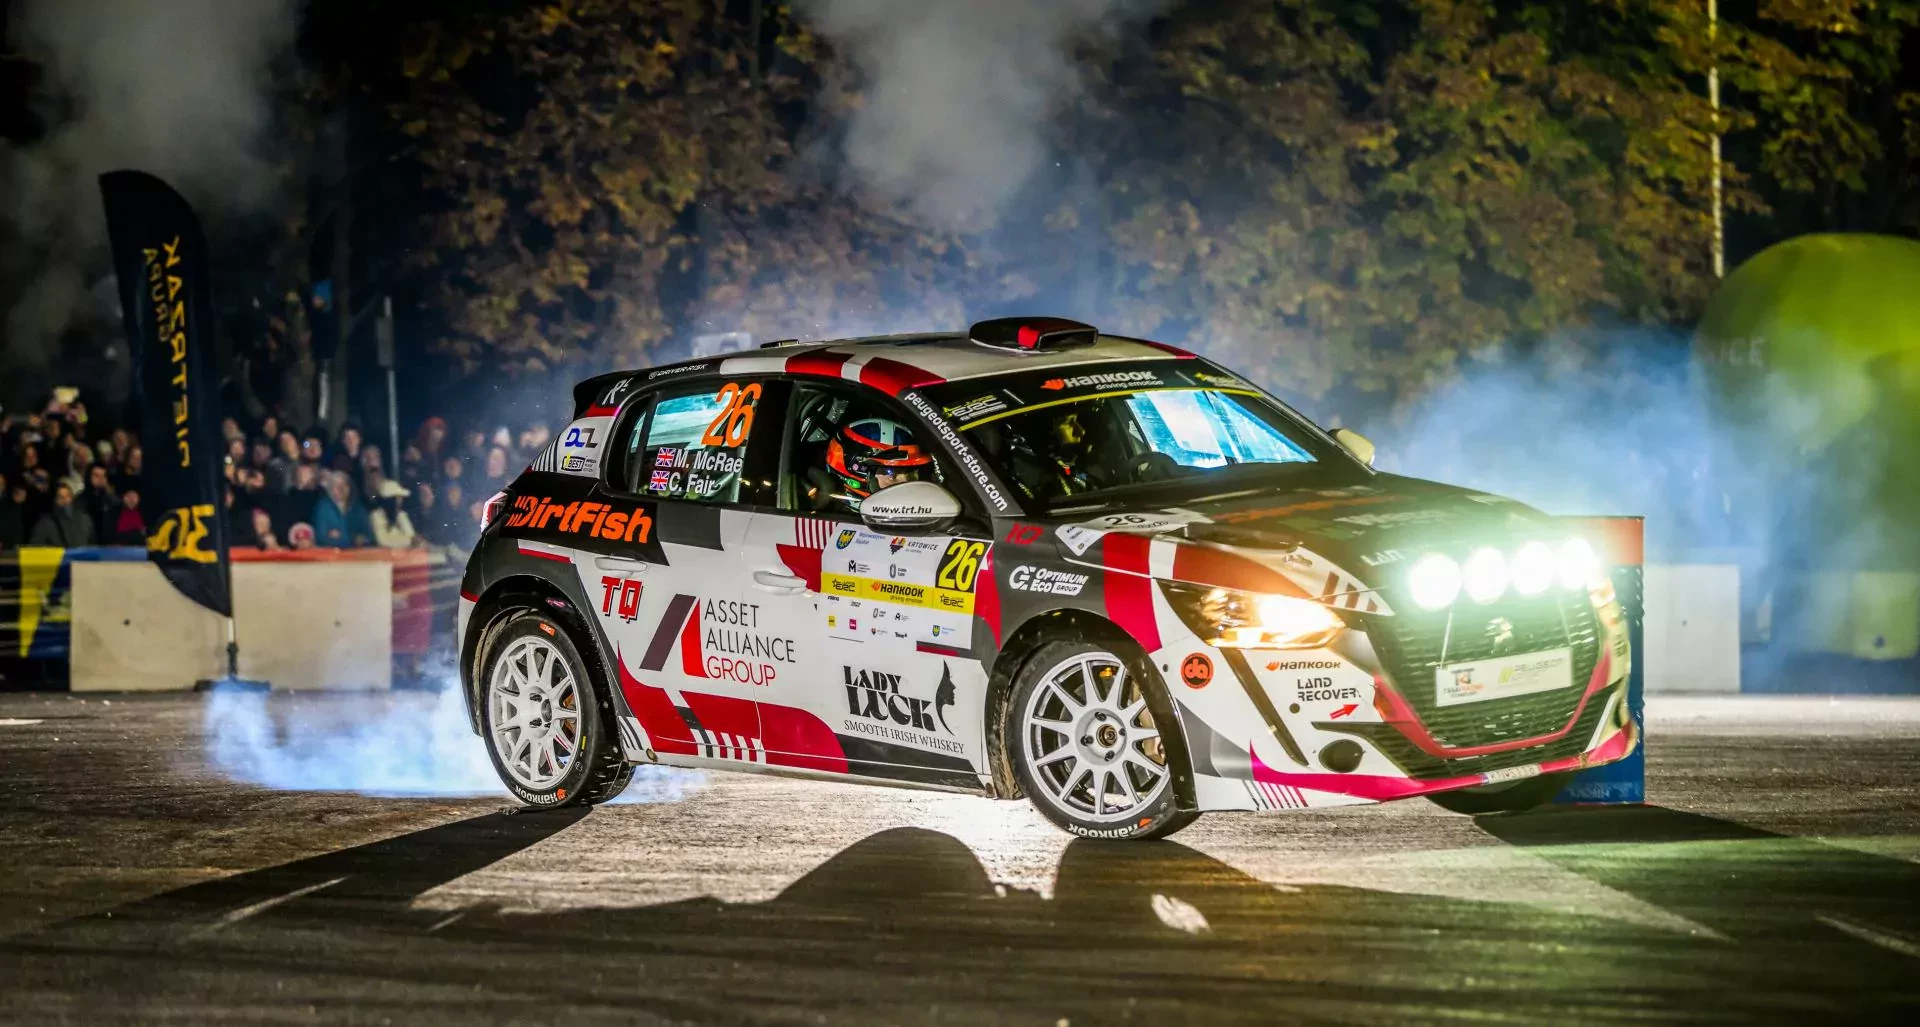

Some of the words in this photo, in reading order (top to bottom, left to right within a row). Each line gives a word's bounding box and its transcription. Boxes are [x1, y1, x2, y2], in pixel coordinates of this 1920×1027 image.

[1095, 383, 1127, 391] driving
[701, 382, 762, 448] 26
[673, 449, 689, 468] M.
[693, 450, 743, 473] McRae
[904, 391, 1009, 512] peugeotsport-store.com
[668, 472, 682, 492] C.
[686, 473, 716, 495] Fair
[505, 495, 653, 544] DirtFish
[872, 505, 932, 515] www.trt.hu
[1105, 514, 1146, 526] 26
[907, 541, 939, 551] KATOWICE
[938, 539, 985, 592] 26
[1036, 567, 1090, 585] OPTIMUM
[601, 575, 644, 624] TQ
[1029, 579, 1053, 593] ECO
[1056, 584, 1078, 593] GROUP
[704, 598, 760, 628] ASSET
[705, 628, 796, 664] ALLIANCE
[707, 655, 776, 687] GROUP
[843, 665, 902, 694] LADY
[1297, 677, 1332, 689] LAND
[846, 685, 937, 732] LUCK
[844, 719, 888, 738] SMOOTH
[891, 729, 918, 745] IRISH
[918, 735, 965, 755] WHISKEY
